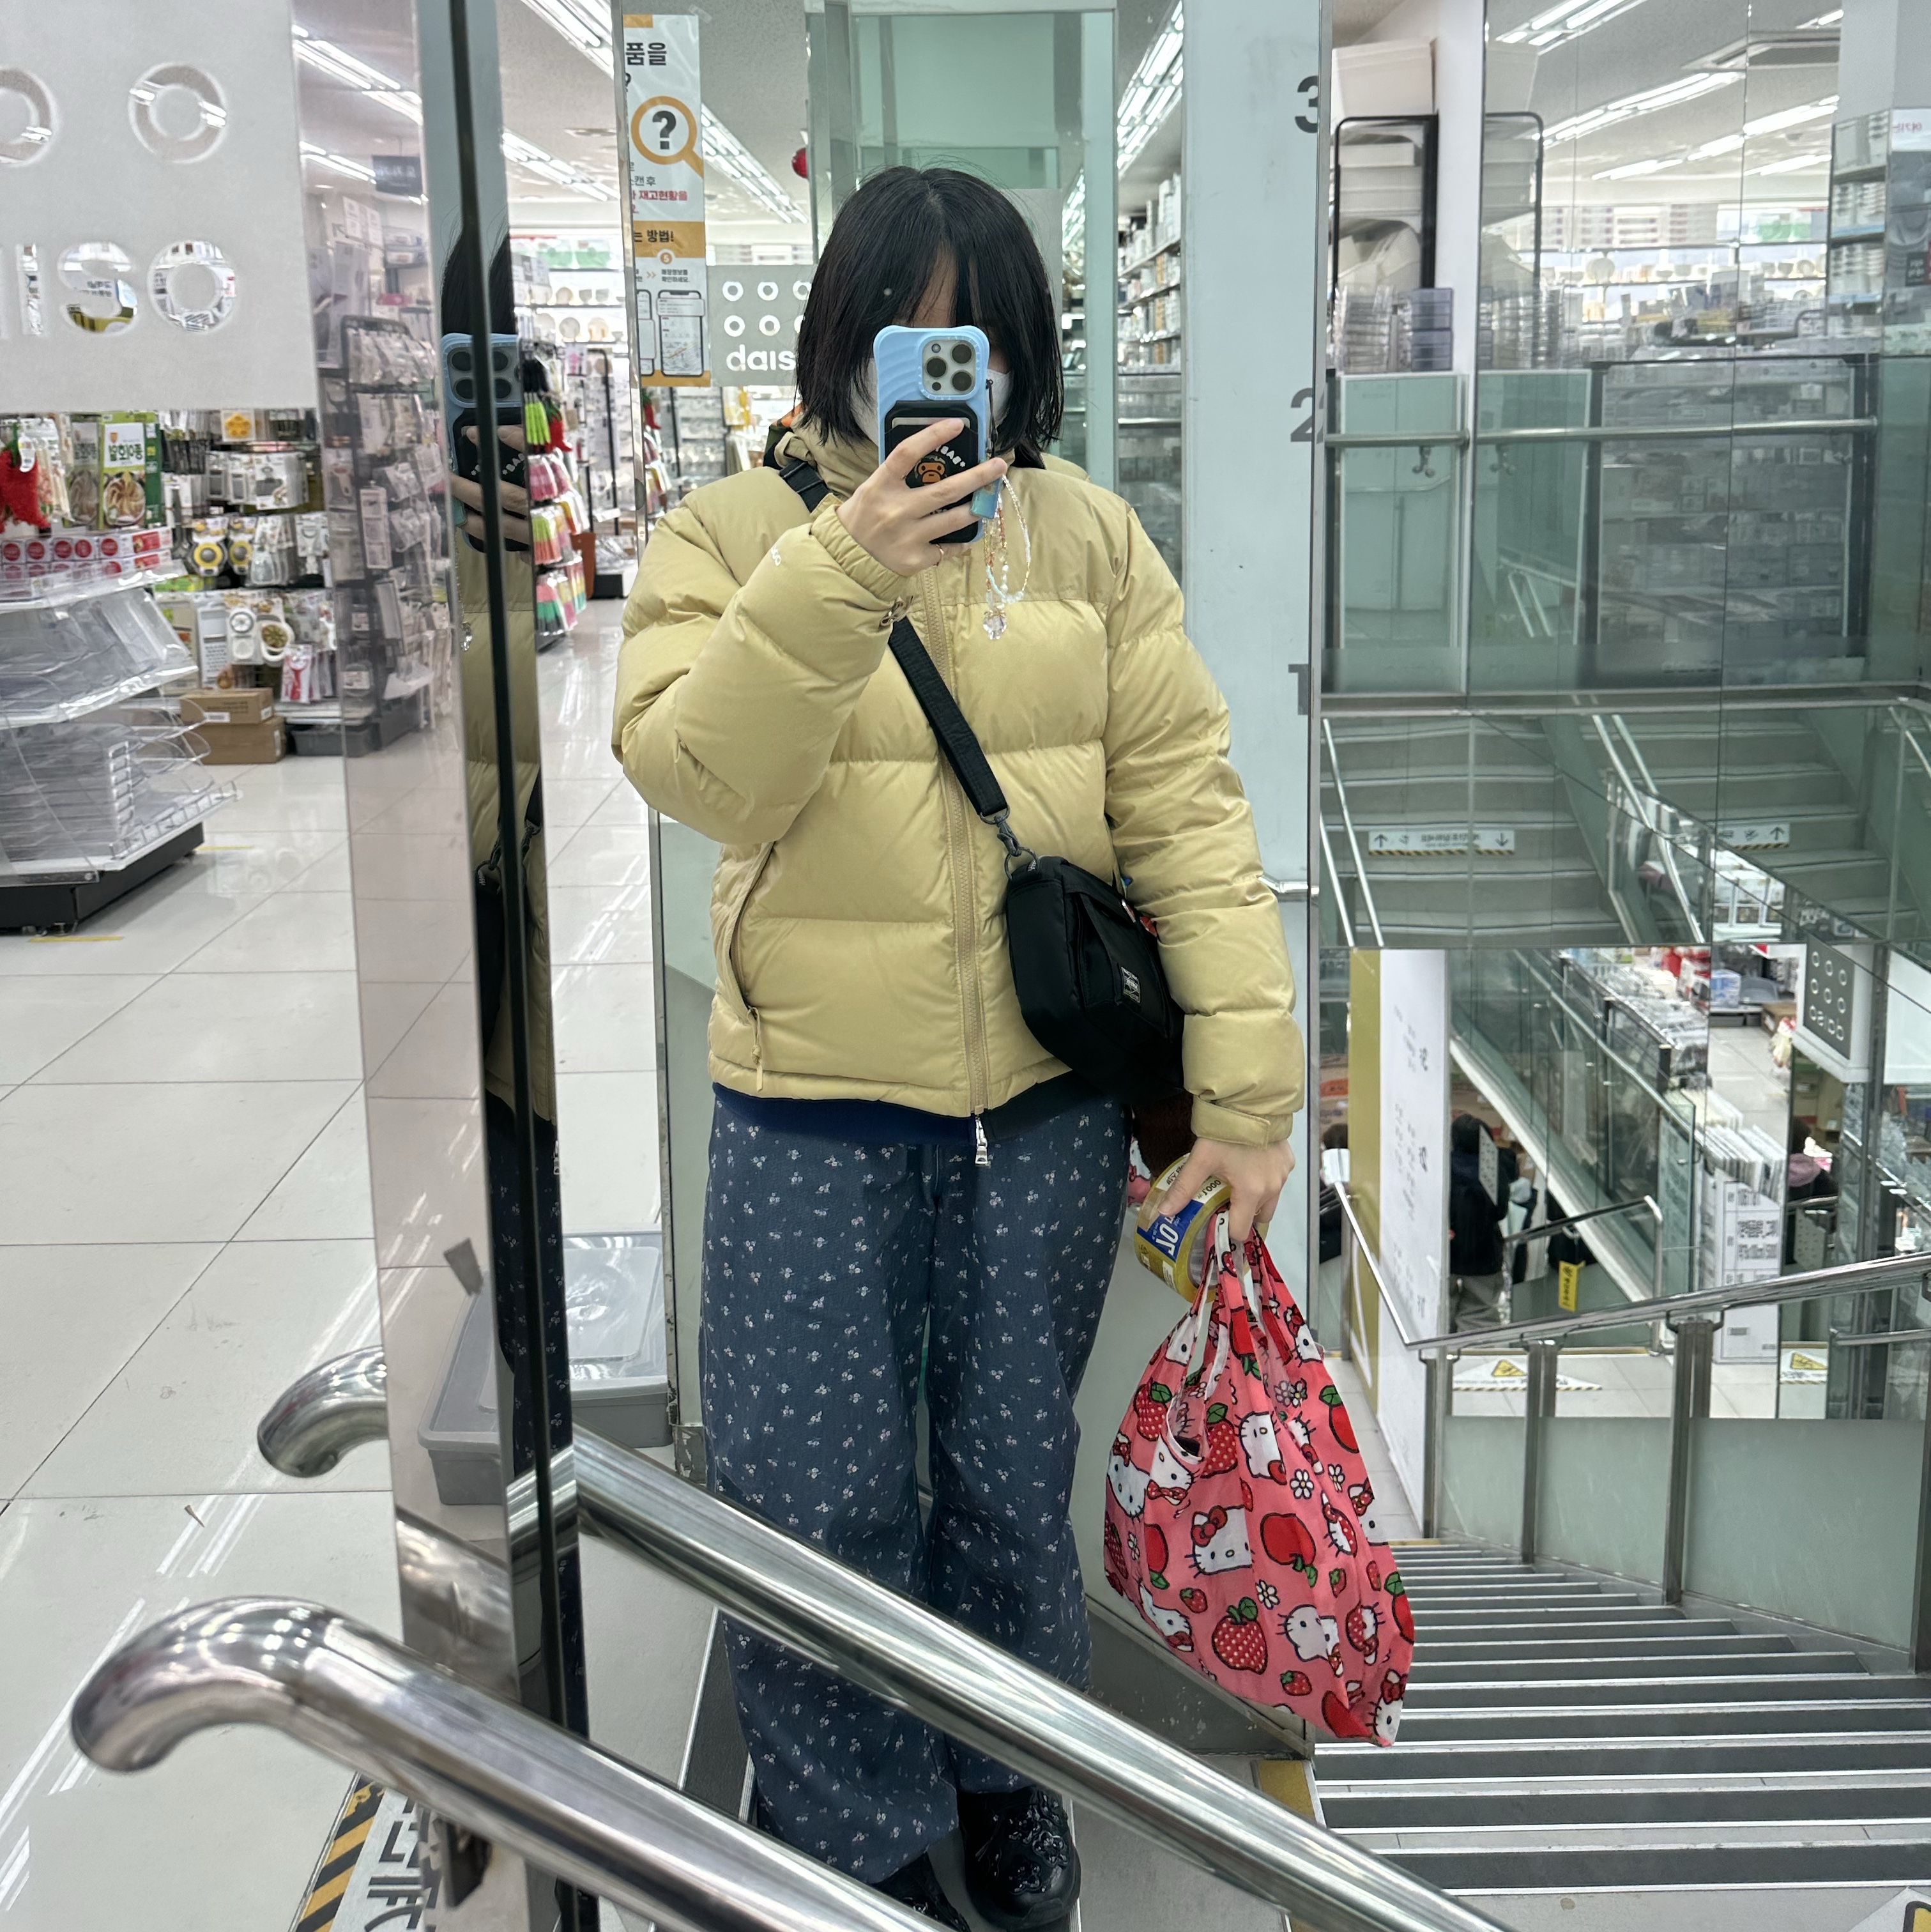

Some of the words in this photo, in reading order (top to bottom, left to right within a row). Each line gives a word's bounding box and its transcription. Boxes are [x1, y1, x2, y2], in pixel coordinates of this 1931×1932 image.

[625, 42, 667, 66] 품을
[646, 176, 657, 187] 후
[639, 190, 688, 201] 재고현황을
[646, 229, 675, 243] 방법!
[0, 240, 237, 338] iso
[726, 344, 797, 372] dais
